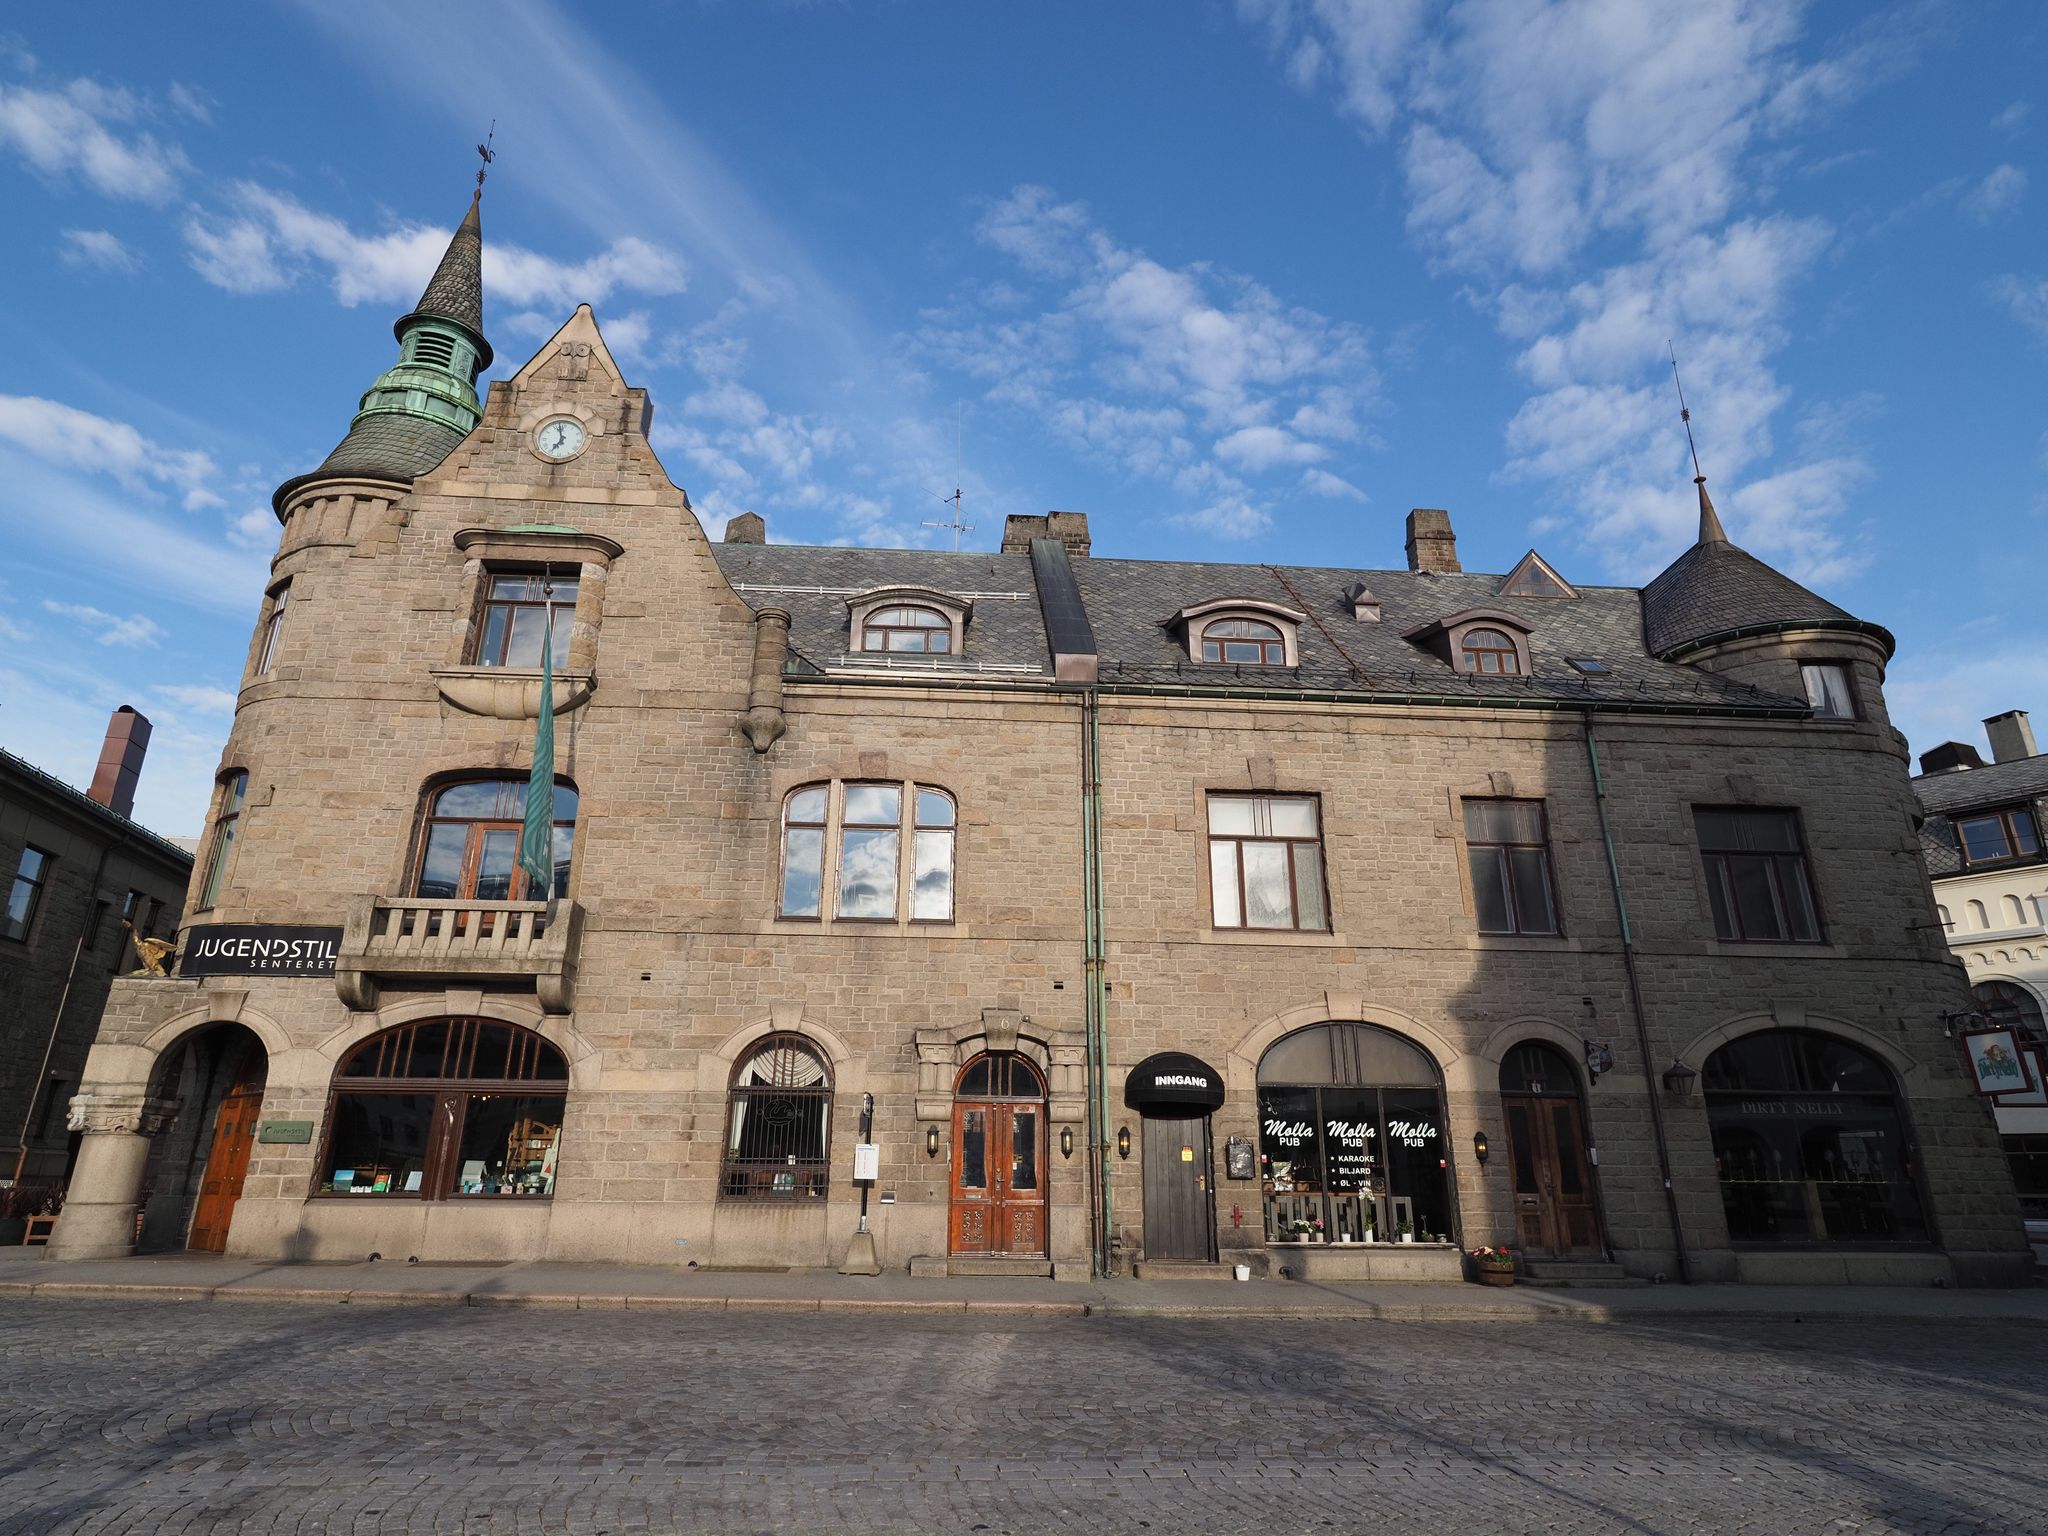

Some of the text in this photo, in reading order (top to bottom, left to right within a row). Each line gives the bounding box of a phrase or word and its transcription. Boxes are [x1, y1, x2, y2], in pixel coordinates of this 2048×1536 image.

[195, 938, 337, 959] JUGENDSTIL
[250, 959, 335, 969] SENTERET
[1000, 1015, 1010, 1030] 6
[1155, 1075, 1207, 1088] INNGANG
[1741, 1101, 1844, 1115] DIRTY NELLY
[1279, 1137, 1300, 1147] PUB
[1342, 1138, 1363, 1148] PUB
[1404, 1138, 1425, 1148] PUB
[1338, 1155, 1375, 1163] KARAOKE
[1339, 1167, 1371, 1175] BILJARD
[1340, 1179, 1351, 1187] ØL
[1357, 1179, 1371, 1187] VIN
